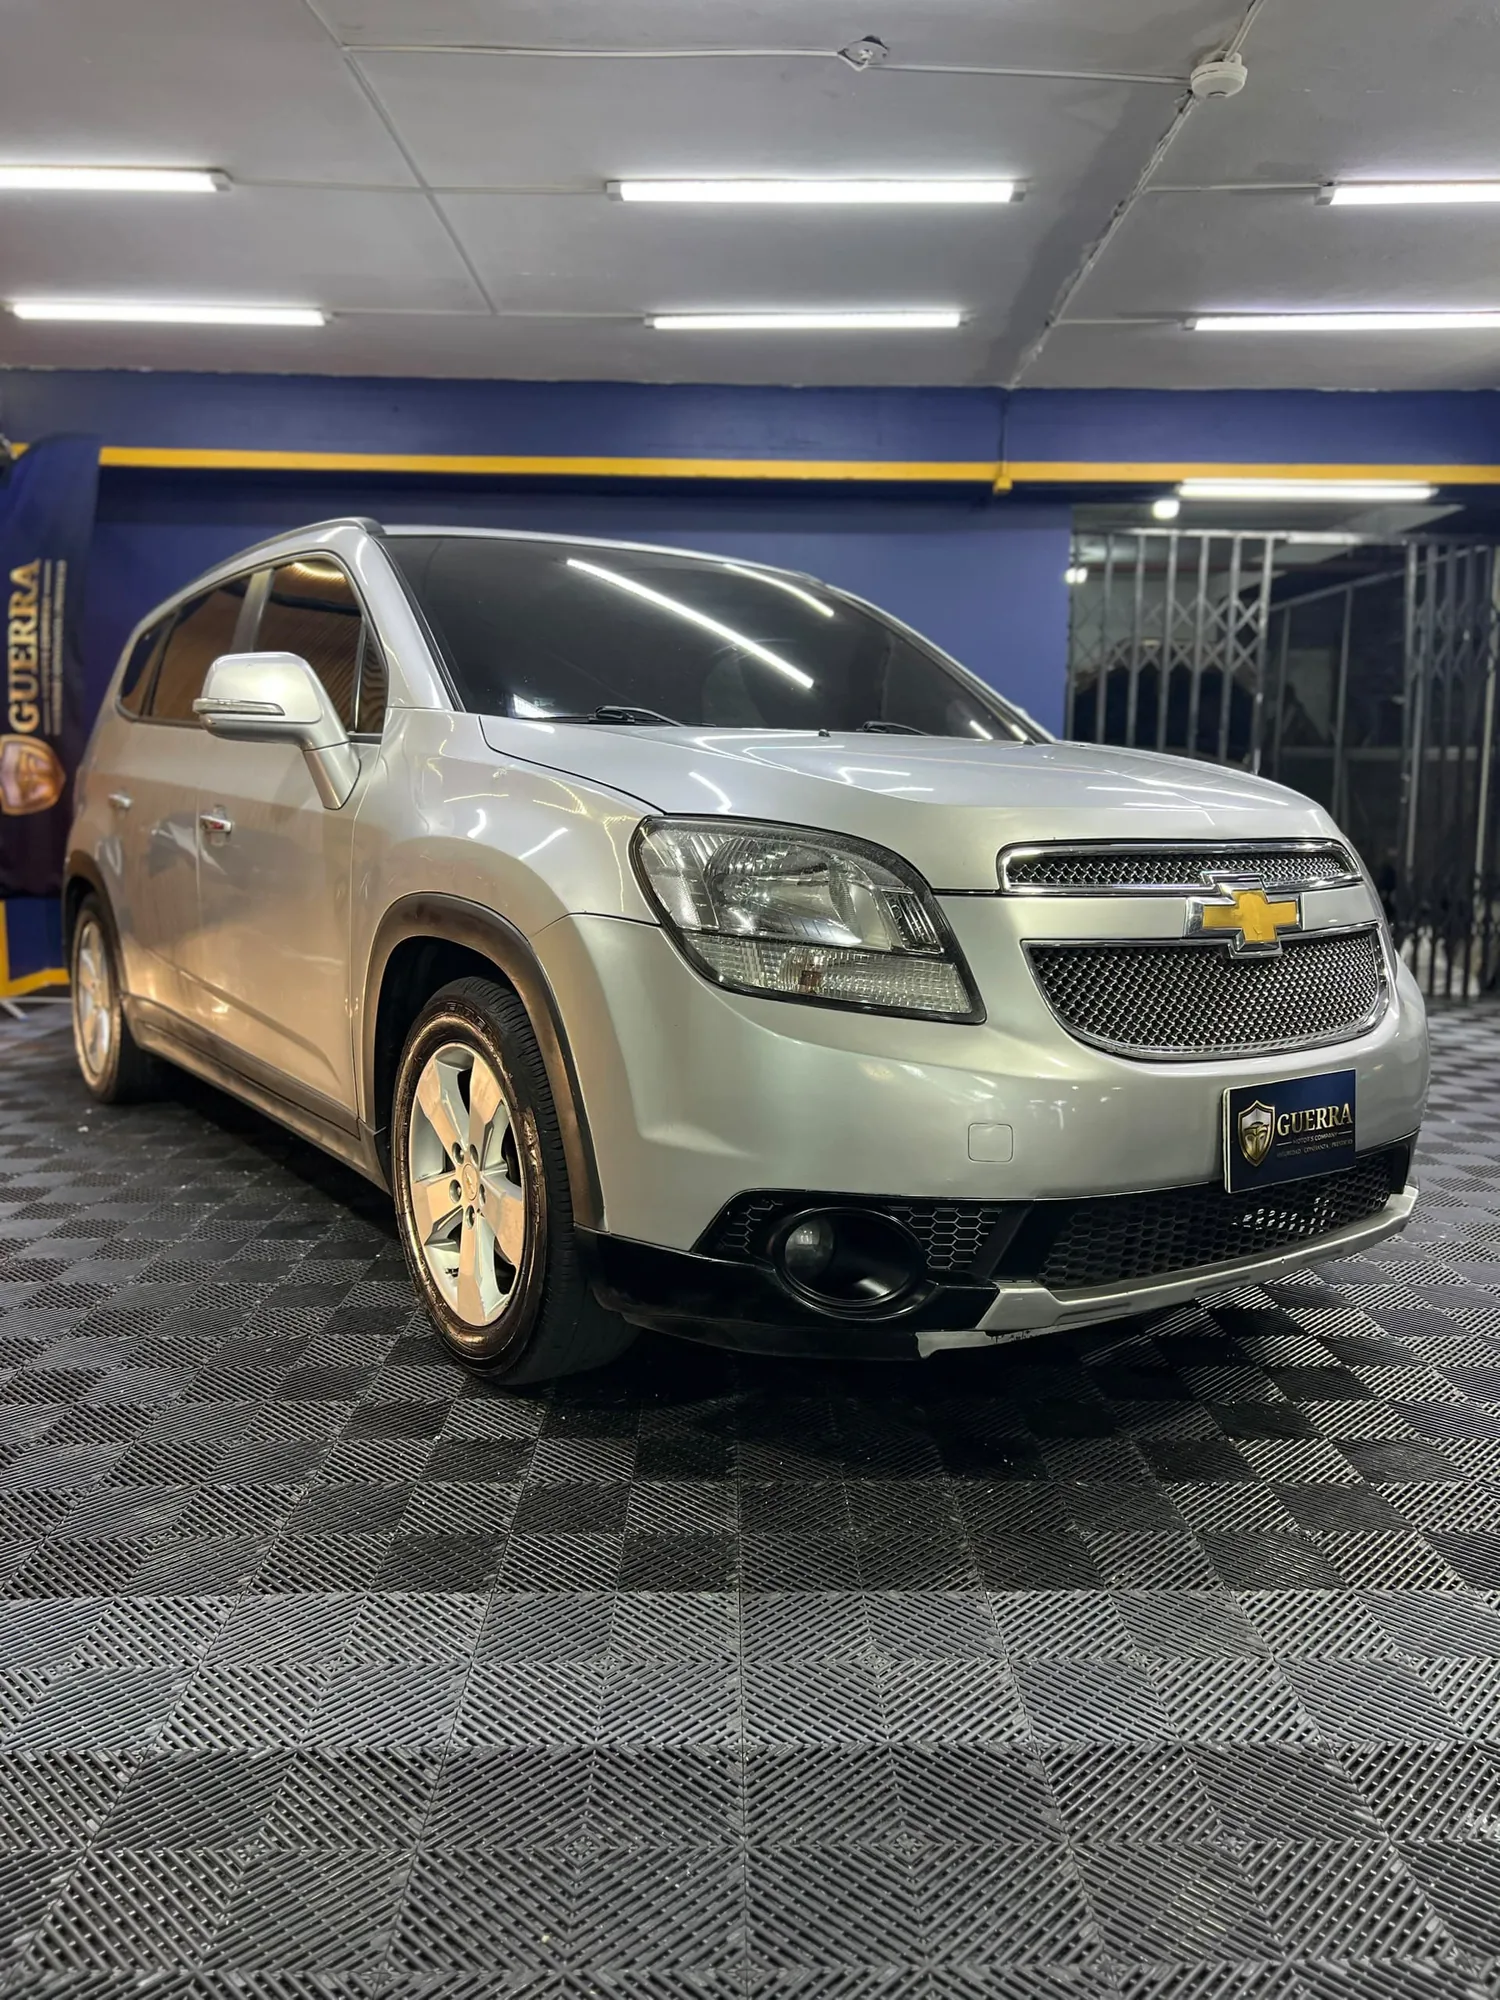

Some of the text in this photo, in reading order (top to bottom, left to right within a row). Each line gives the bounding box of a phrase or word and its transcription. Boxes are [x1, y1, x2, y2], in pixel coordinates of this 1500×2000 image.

[8, 558, 41, 734] GUERRA
[1277, 1103, 1353, 1136] GUERRA
[1314, 1132, 1338, 1141] COMPANY
